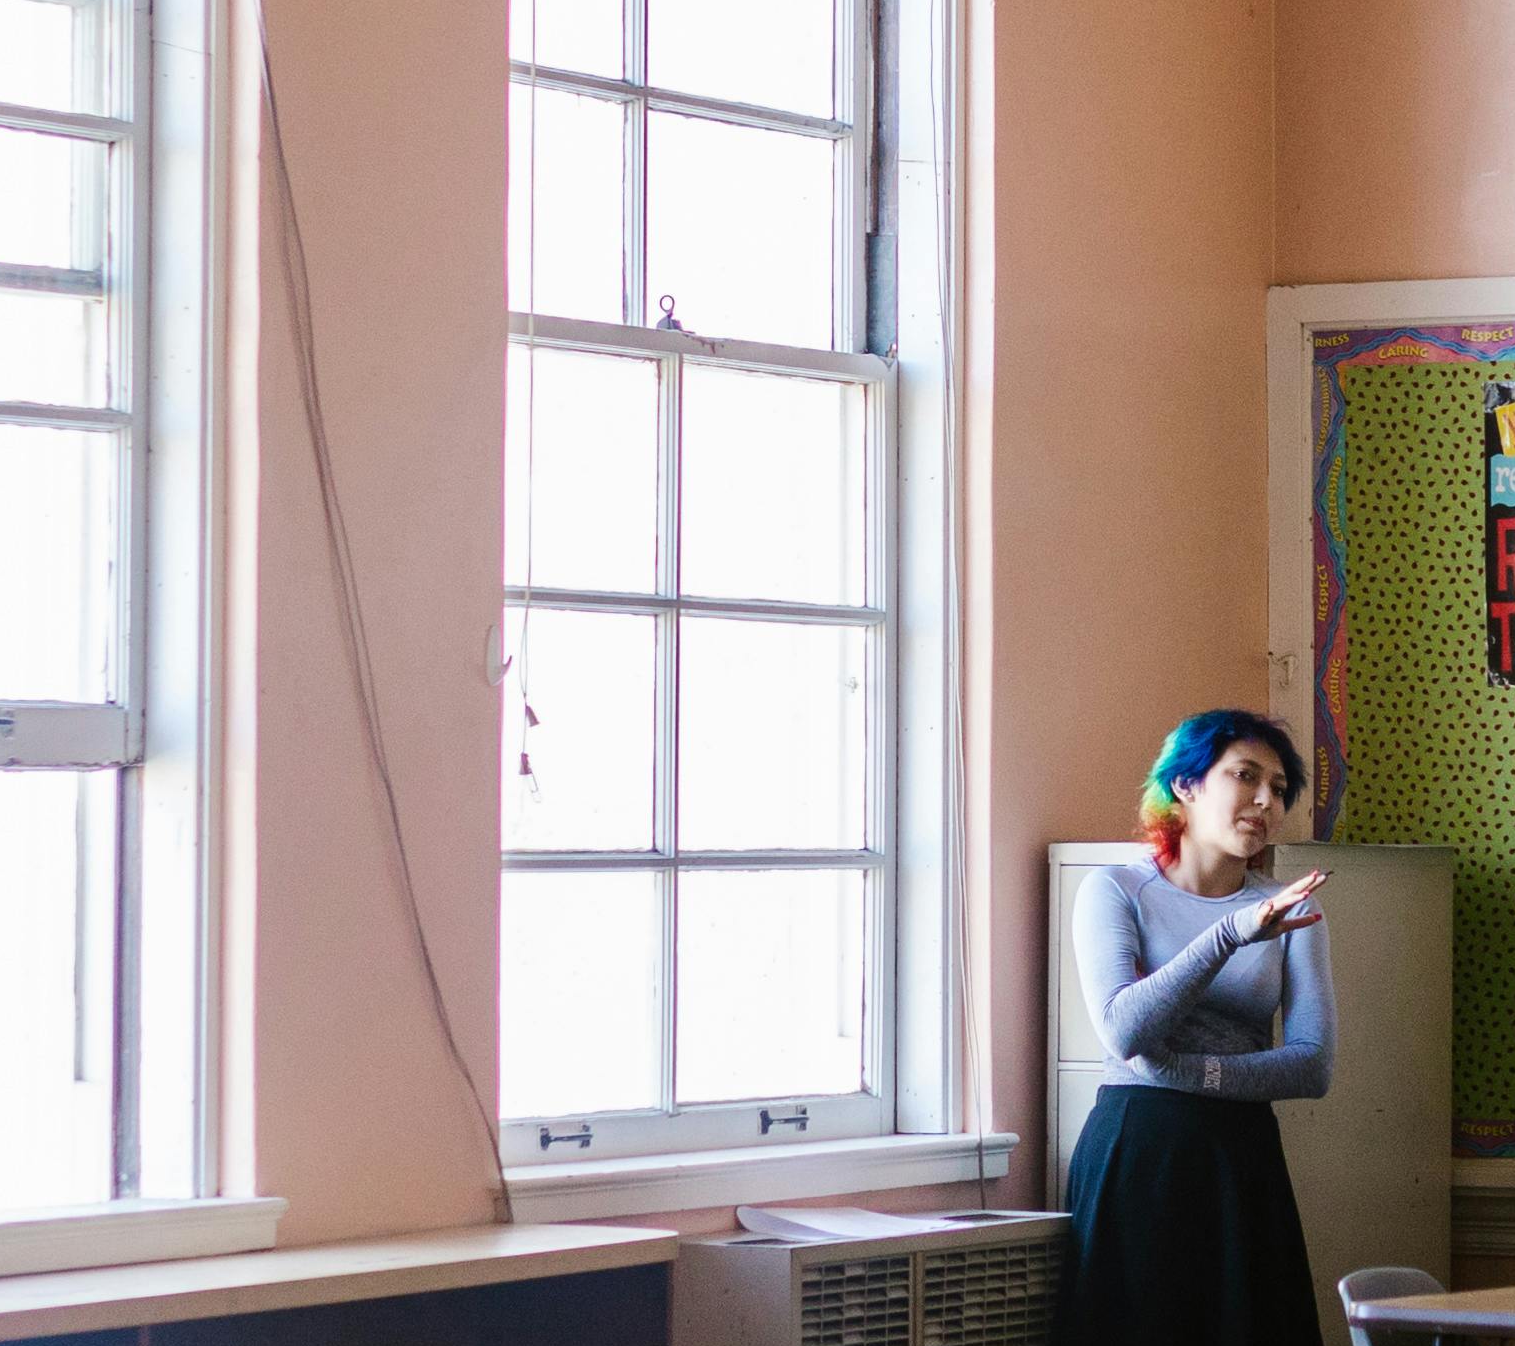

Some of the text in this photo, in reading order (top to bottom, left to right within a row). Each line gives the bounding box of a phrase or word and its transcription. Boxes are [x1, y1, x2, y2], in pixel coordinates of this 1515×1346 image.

[1314, 332, 1350, 348] RNESS
[1461, 326, 1514, 343] RESPECT
[1379, 343, 1428, 359] CARING
[1317, 563, 1329, 621] RESPECT
[1332, 658, 1342, 714] CARING
[1317, 746, 1329, 807] FAIRNESS
[1460, 1123, 1515, 1137] RESPECT
